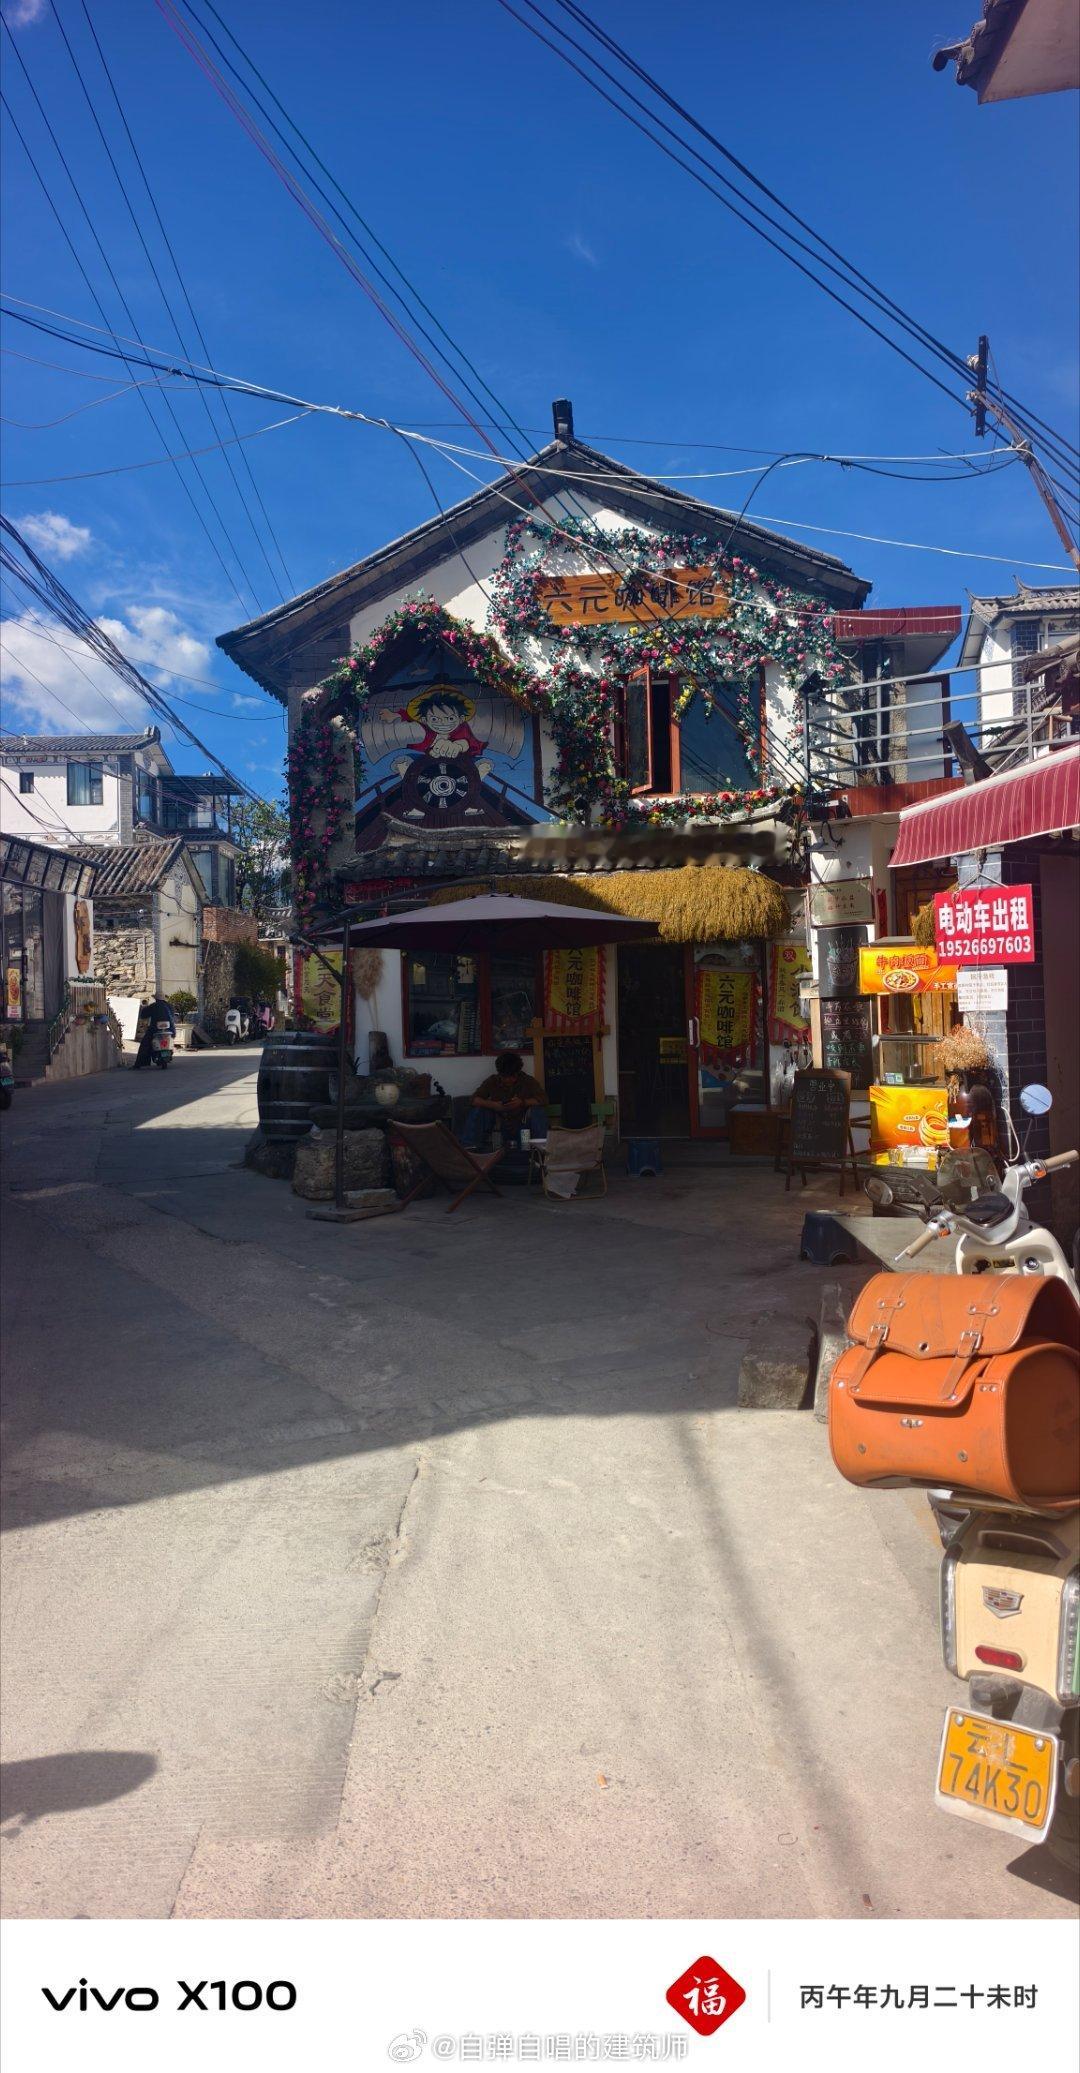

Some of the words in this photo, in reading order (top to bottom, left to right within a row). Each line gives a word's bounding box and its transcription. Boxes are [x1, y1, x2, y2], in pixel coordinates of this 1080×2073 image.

[938, 896, 1030, 937] 电动车出租
[938, 936, 1032, 958] 19526697603
[716, 975, 736, 1048] 六元咖啡馆
[949, 1752, 1042, 1819] 74K30
